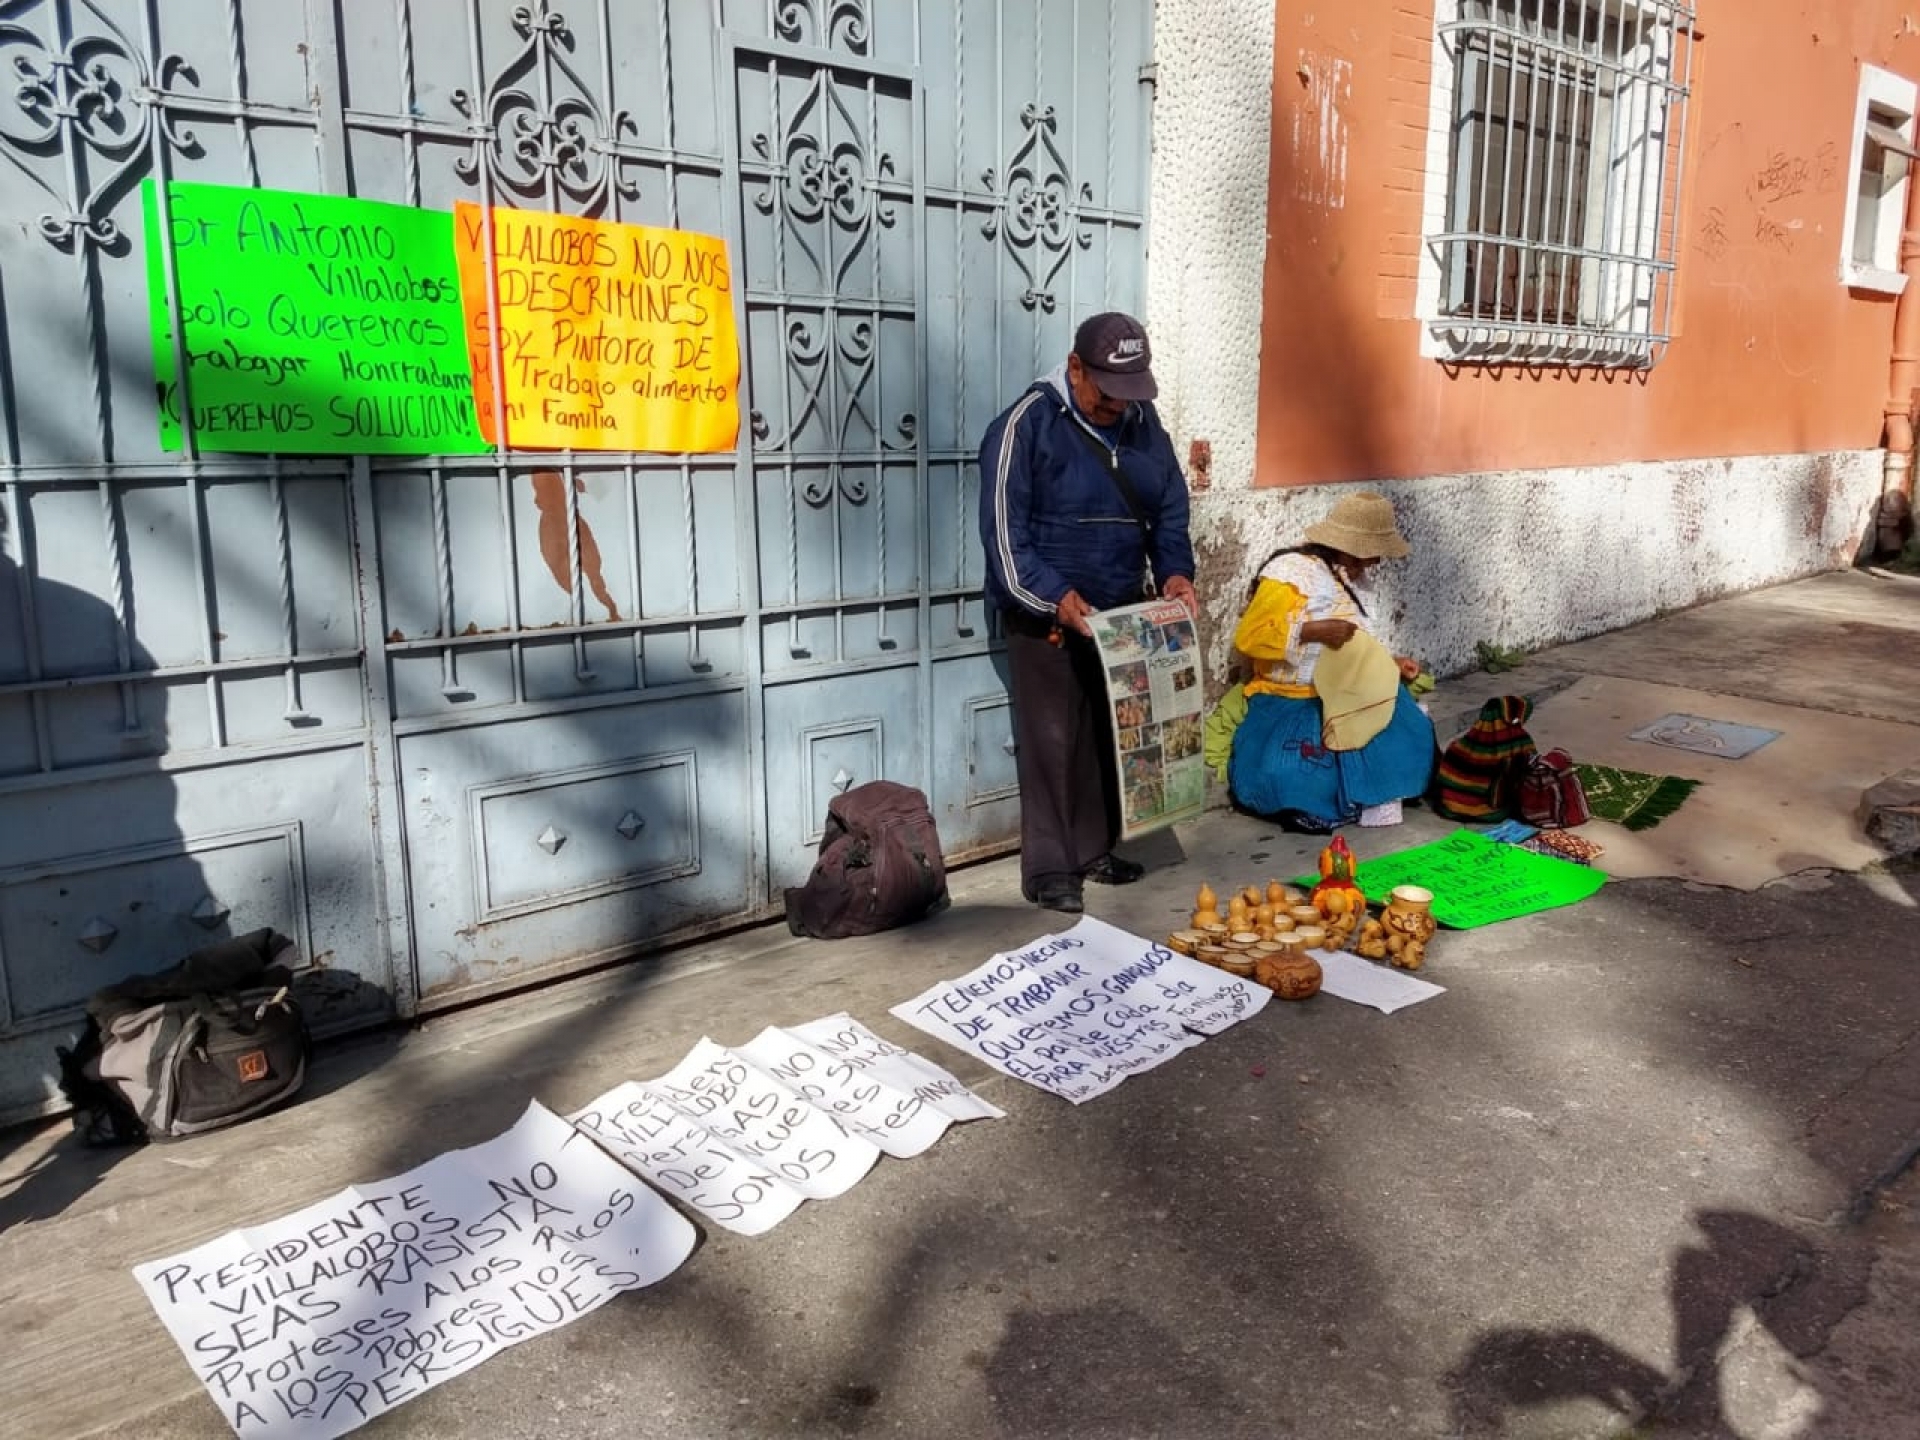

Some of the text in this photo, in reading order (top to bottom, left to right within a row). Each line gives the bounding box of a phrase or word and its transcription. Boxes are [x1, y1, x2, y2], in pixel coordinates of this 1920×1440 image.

[463, 214, 730, 292] VLALOBOS NO NOS
[499, 269, 708, 327] DESCRIMINES
[185, 339, 312, 386] rabajar
[674, 336, 714, 372] DE
[1118, 339, 1144, 354] NIKE
[952, 1015, 993, 1041] DE
[769, 1052, 816, 1080] NO
[208, 1161, 559, 1315] VILLALOBOS NO
[194, 1197, 575, 1369] SEAS RASISTA
[423, 1281, 452, 1309] A
[234, 1400, 268, 1429] A
[273, 1364, 354, 1419] LOS
